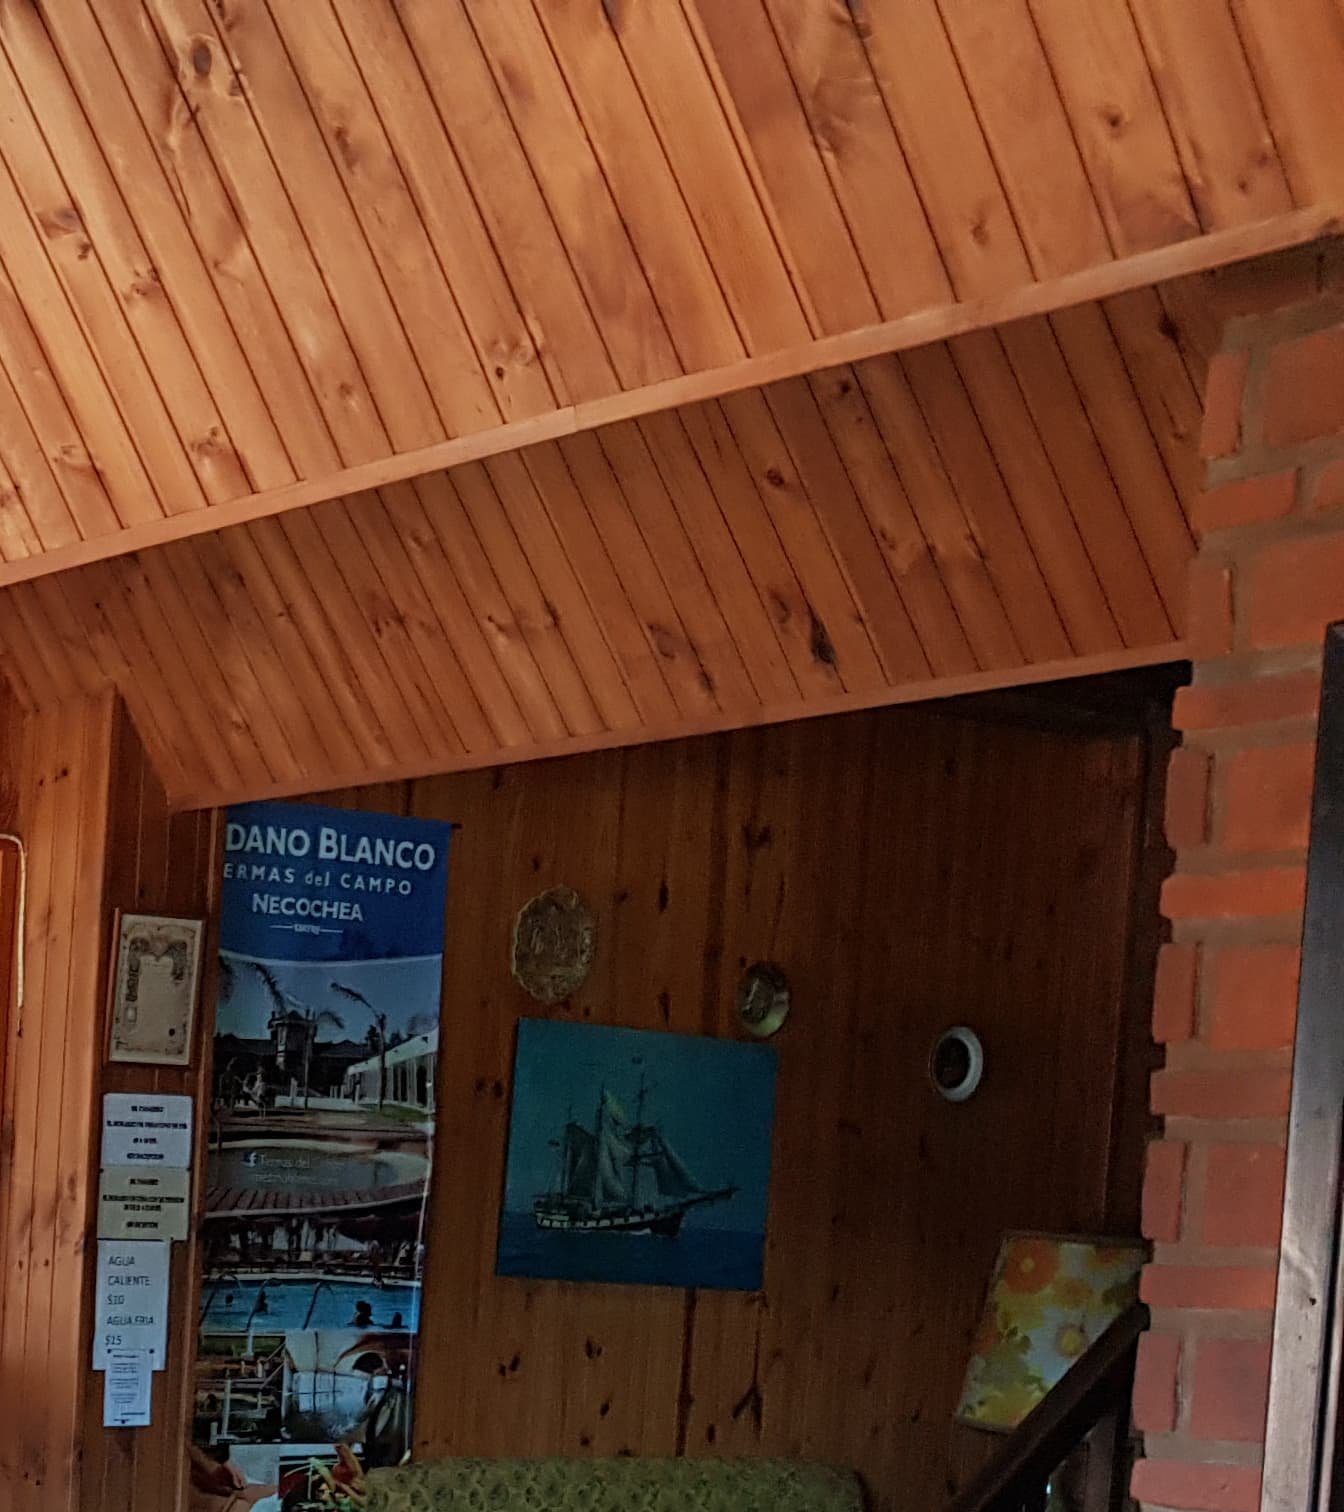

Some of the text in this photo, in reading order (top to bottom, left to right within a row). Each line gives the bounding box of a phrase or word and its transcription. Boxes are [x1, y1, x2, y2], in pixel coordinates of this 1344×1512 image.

[318, 827, 435, 870] BLANCO
[305, 871, 330, 887] del
[340, 873, 412, 895] CAMPO
[252, 893, 364, 922] NECOCHEA
[108, 1255, 135, 1266] AGUA
[108, 1275, 151, 1286] CALIENTE
[106, 1315, 133, 1326] AGUA
